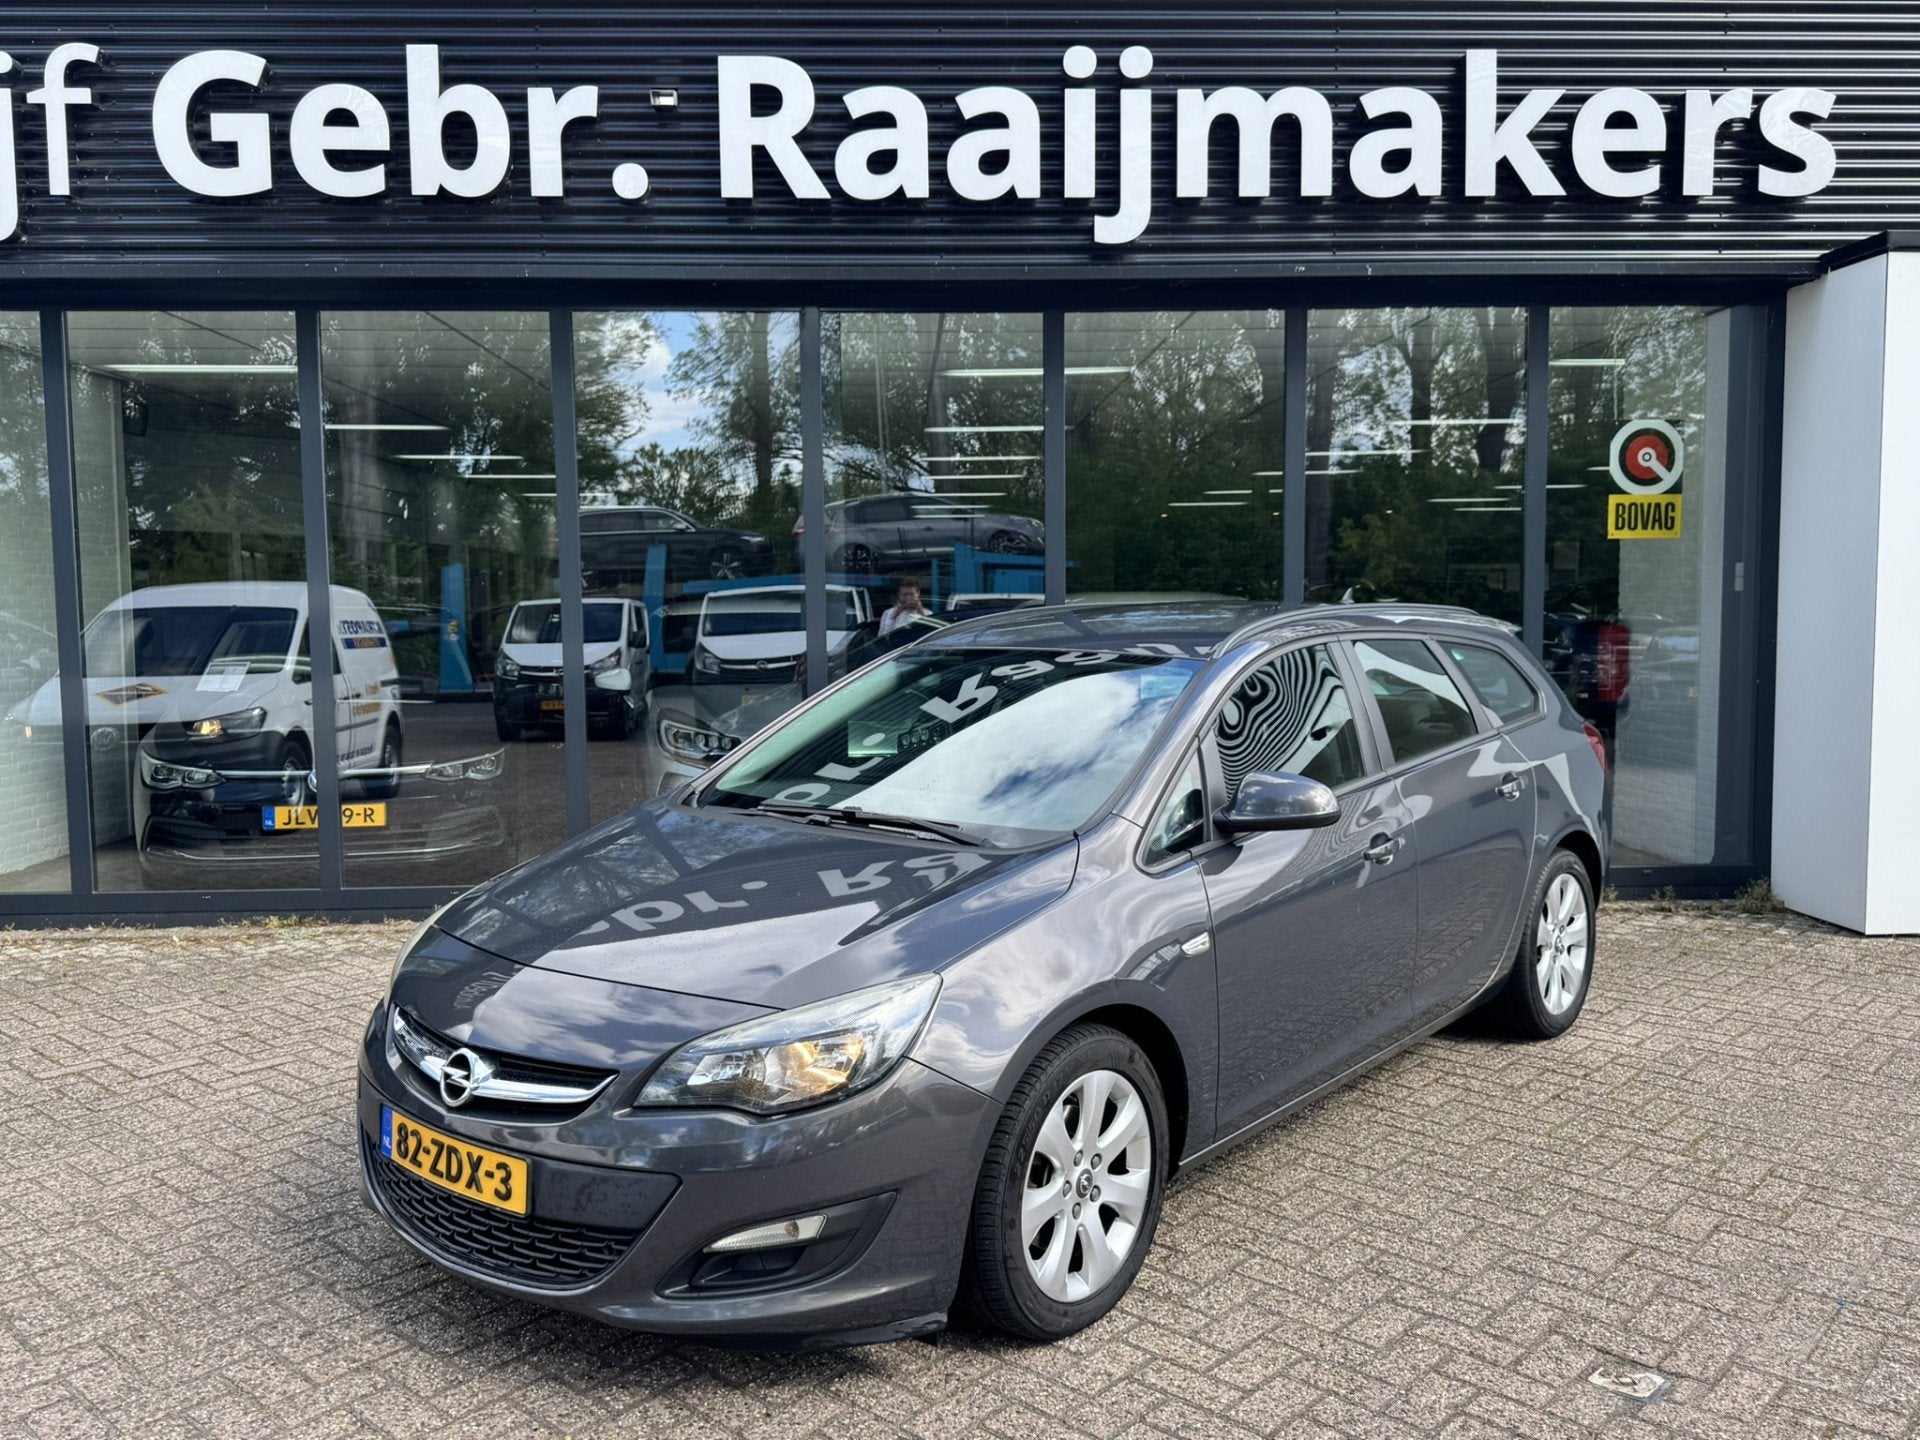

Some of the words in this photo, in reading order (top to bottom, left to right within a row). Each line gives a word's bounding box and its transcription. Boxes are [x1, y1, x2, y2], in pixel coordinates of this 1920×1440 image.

[152, 44, 649, 199] Gebr.
[717, 45, 1837, 244] Raaijmakers
[1615, 502, 1676, 531] BOVAG
[396, 1122, 513, 1202] 82-ZDX-3
